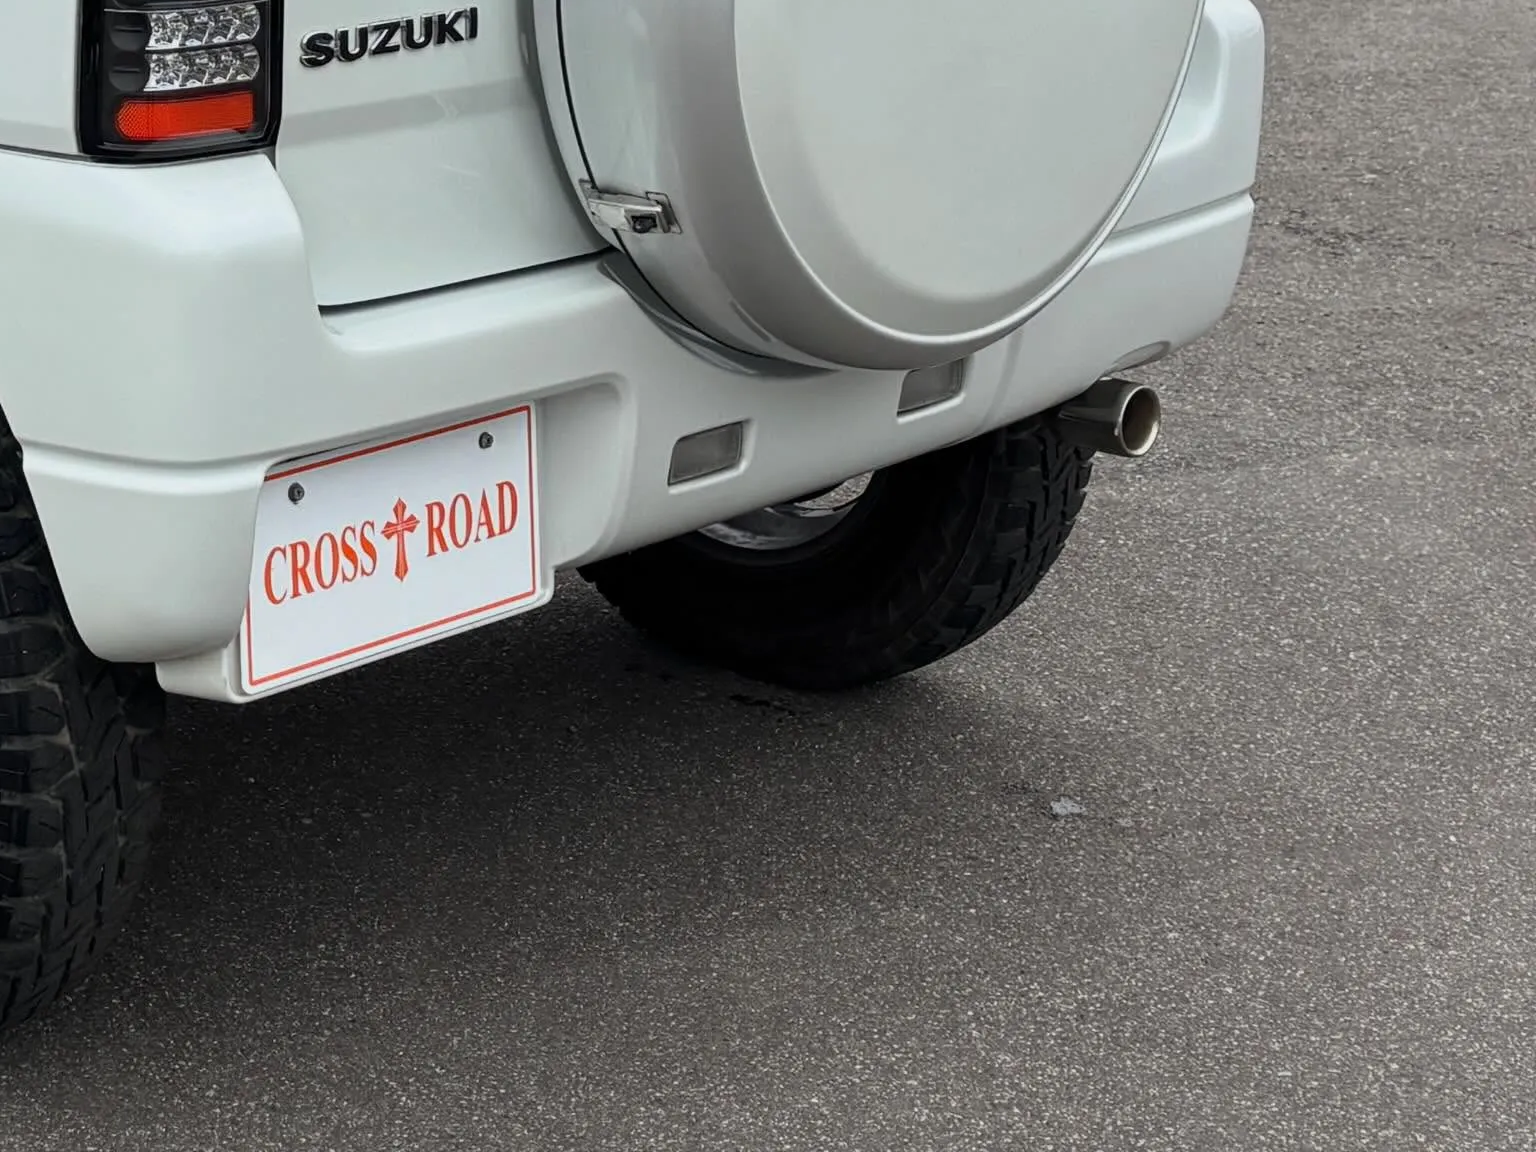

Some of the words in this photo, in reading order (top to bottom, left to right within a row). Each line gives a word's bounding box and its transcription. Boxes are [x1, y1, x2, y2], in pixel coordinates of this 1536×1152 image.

[300, 6, 479, 68] SUZUKI
[263, 520, 378, 606] CROSS
[424, 480, 519, 558] ROAD
